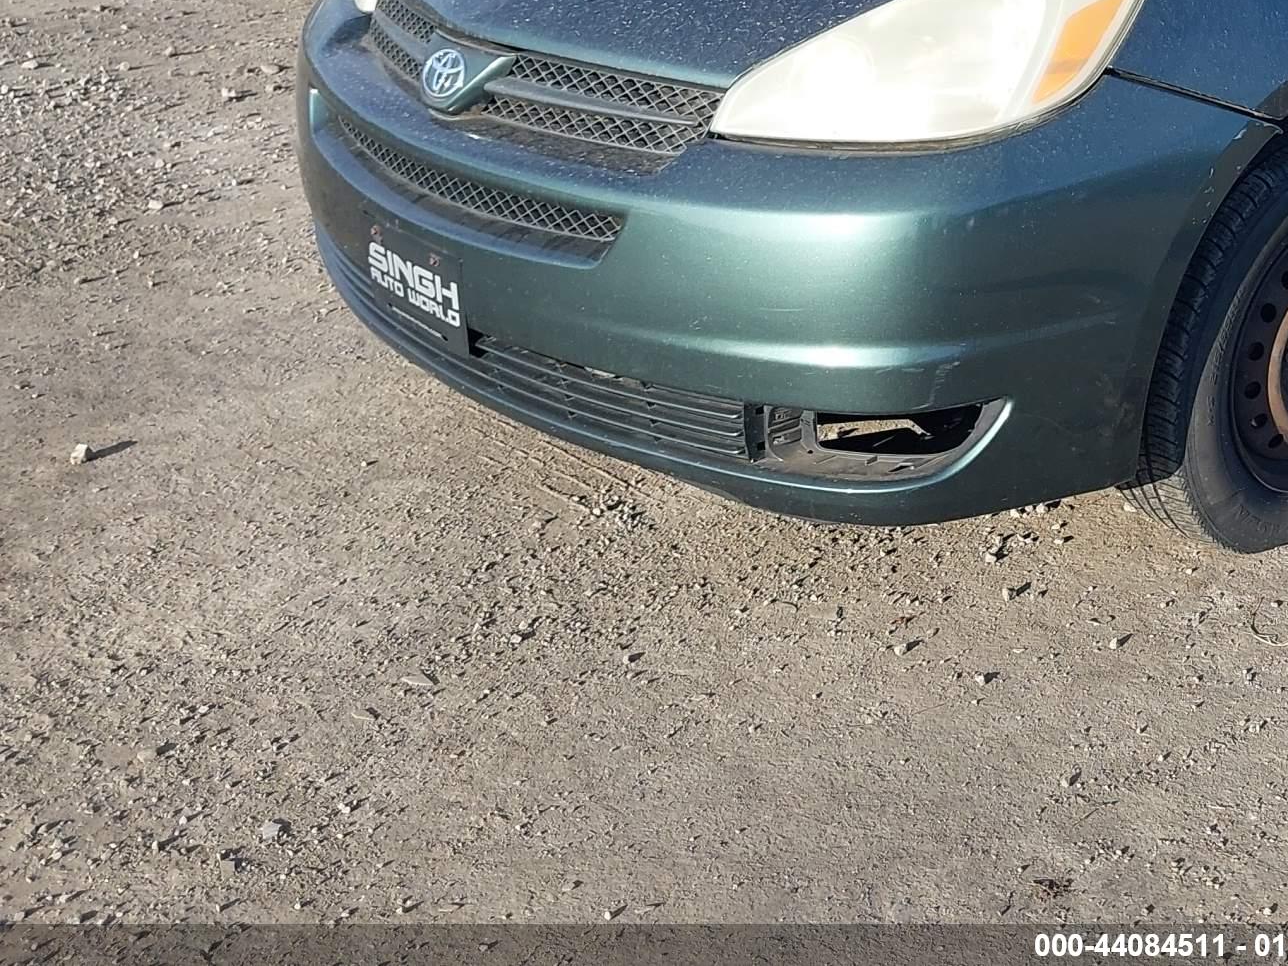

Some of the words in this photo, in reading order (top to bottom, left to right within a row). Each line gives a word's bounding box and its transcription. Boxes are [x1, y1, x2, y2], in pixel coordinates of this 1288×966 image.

[367, 241, 460, 311] SINGH
[369, 265, 405, 298] AUTO
[406, 287, 461, 328] WORLD
